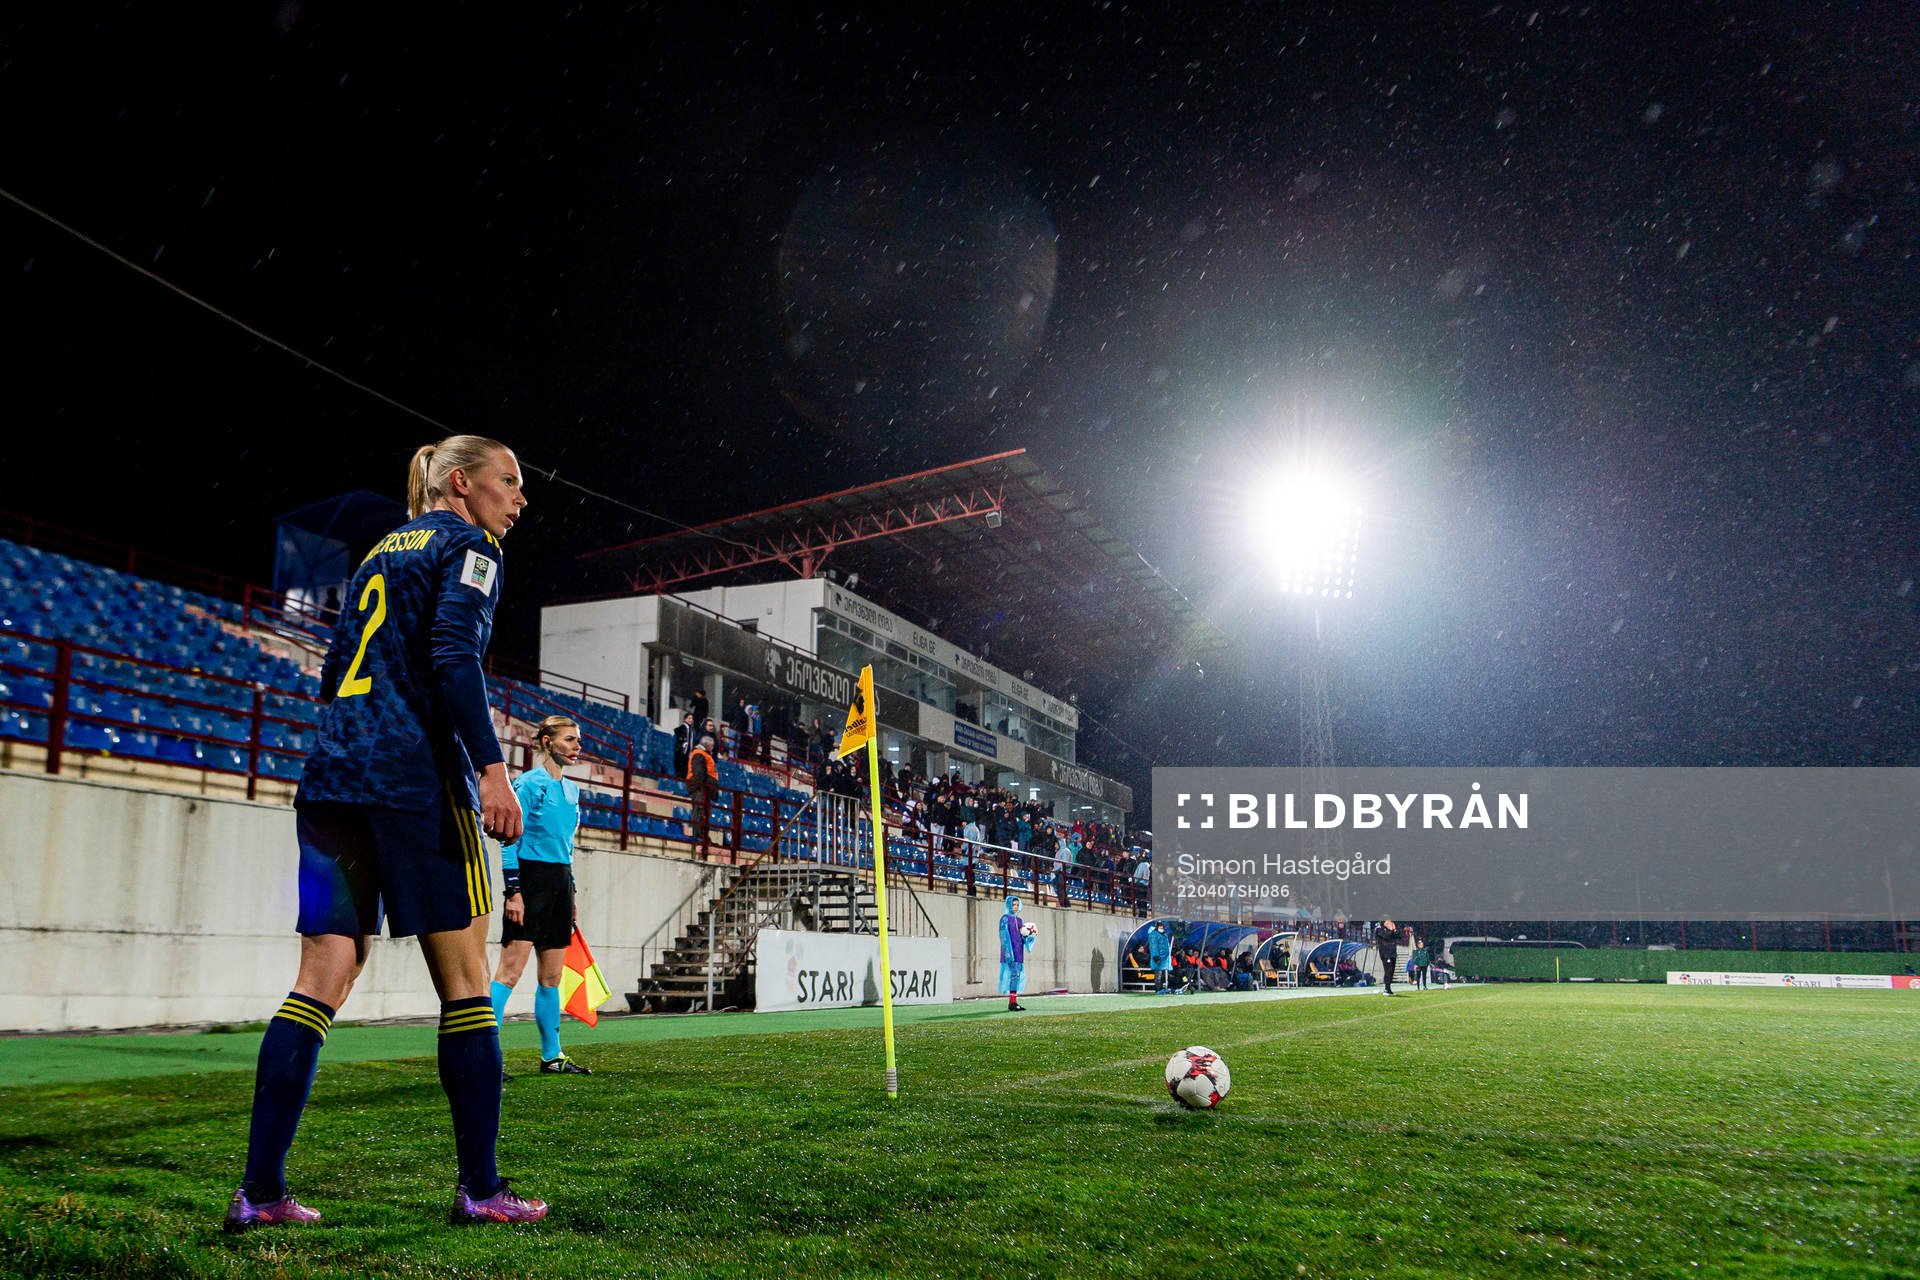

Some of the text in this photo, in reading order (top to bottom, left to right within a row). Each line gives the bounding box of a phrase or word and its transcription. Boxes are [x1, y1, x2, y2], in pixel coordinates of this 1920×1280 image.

[360, 529, 437, 566] ERSSON
[337, 573, 387, 698] 2
[786, 655, 850, 706] ეროვნული
[797, 969, 938, 1003] STARI STARI
